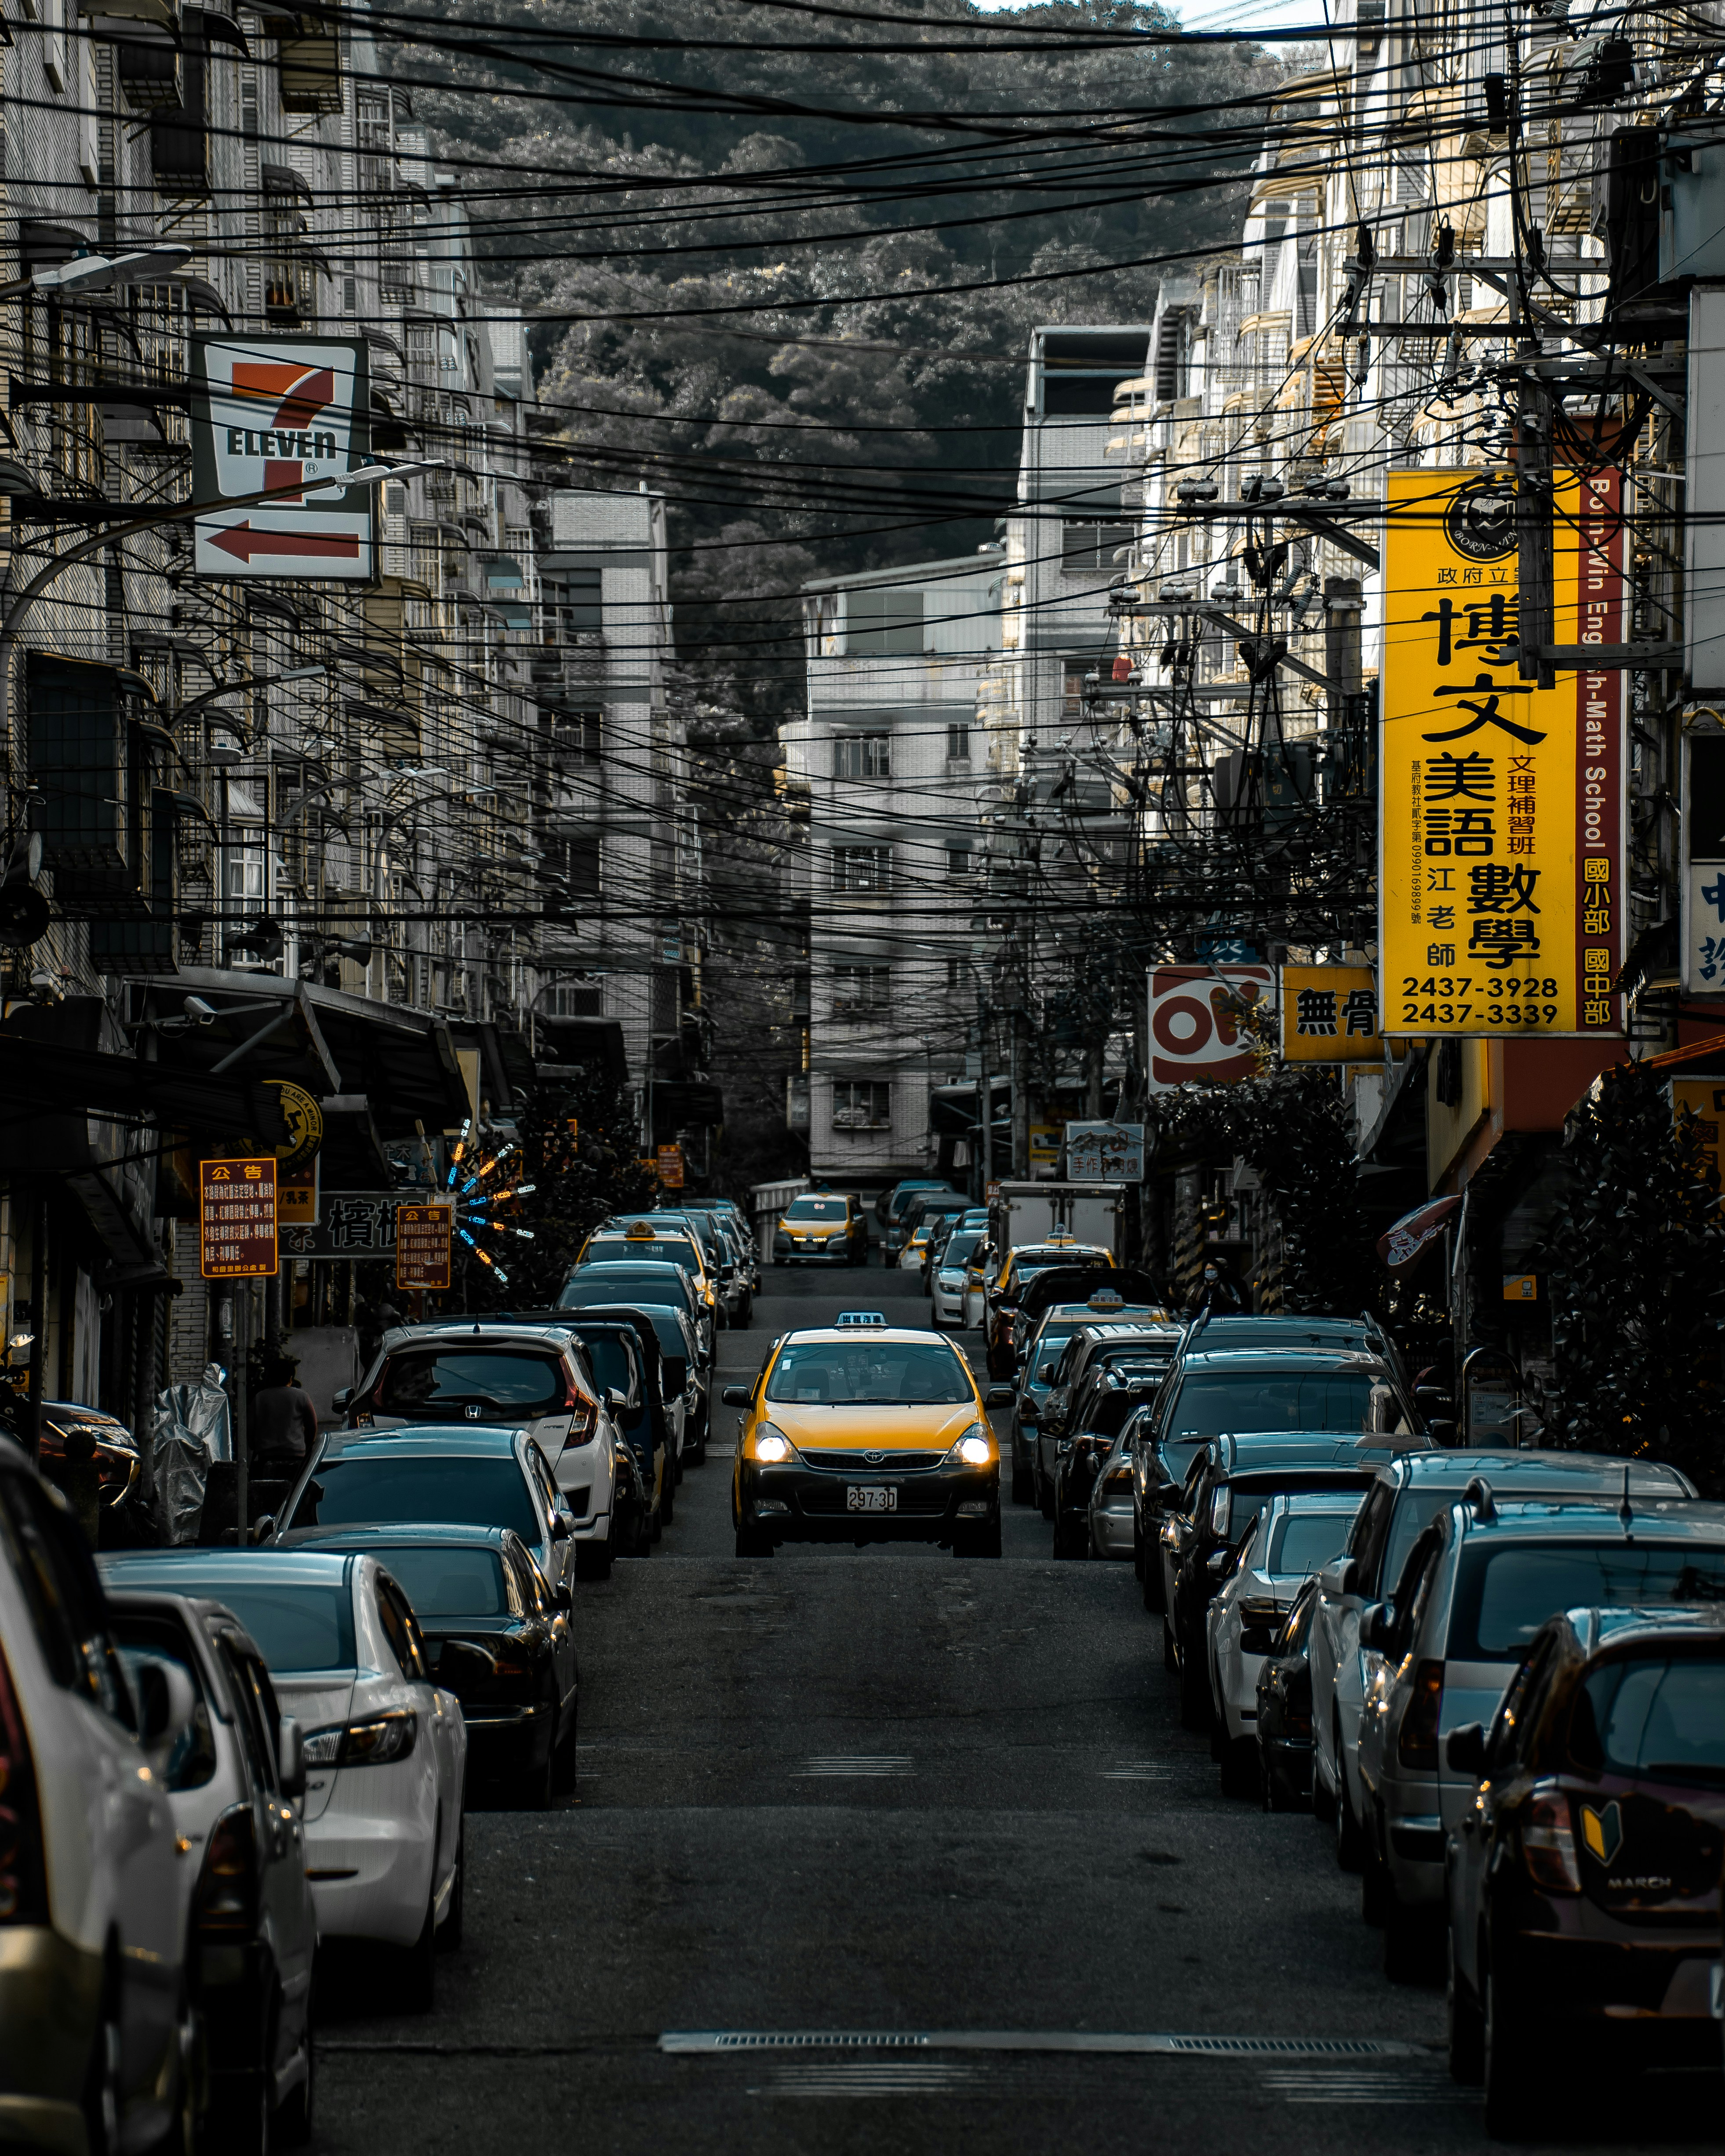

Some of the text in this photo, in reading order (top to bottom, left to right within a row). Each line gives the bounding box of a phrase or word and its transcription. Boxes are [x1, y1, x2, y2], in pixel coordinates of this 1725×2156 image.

[1507, 755, 1536, 855] 文理補習班
[1585, 766, 1607, 847] School
[1427, 866, 1456, 968] 江老師
[1466, 862, 1542, 970] 數學
[1582, 856, 1612, 1026] 國小部 國中部
[1402, 976, 1558, 998] 2437-3928
[1296, 987, 1379, 1037] 無骨
[1402, 1003, 1558, 1025] 2437-3339
[291, 1091, 304, 1102] ARE
[306, 1108, 317, 1131] MINOR
[212, 1165, 262, 1180] 公告
[406, 1211, 440, 1221] 公告
[842, 1315, 881, 1324] 出租汽車
[1607, 1876, 1673, 1891] MARCH
